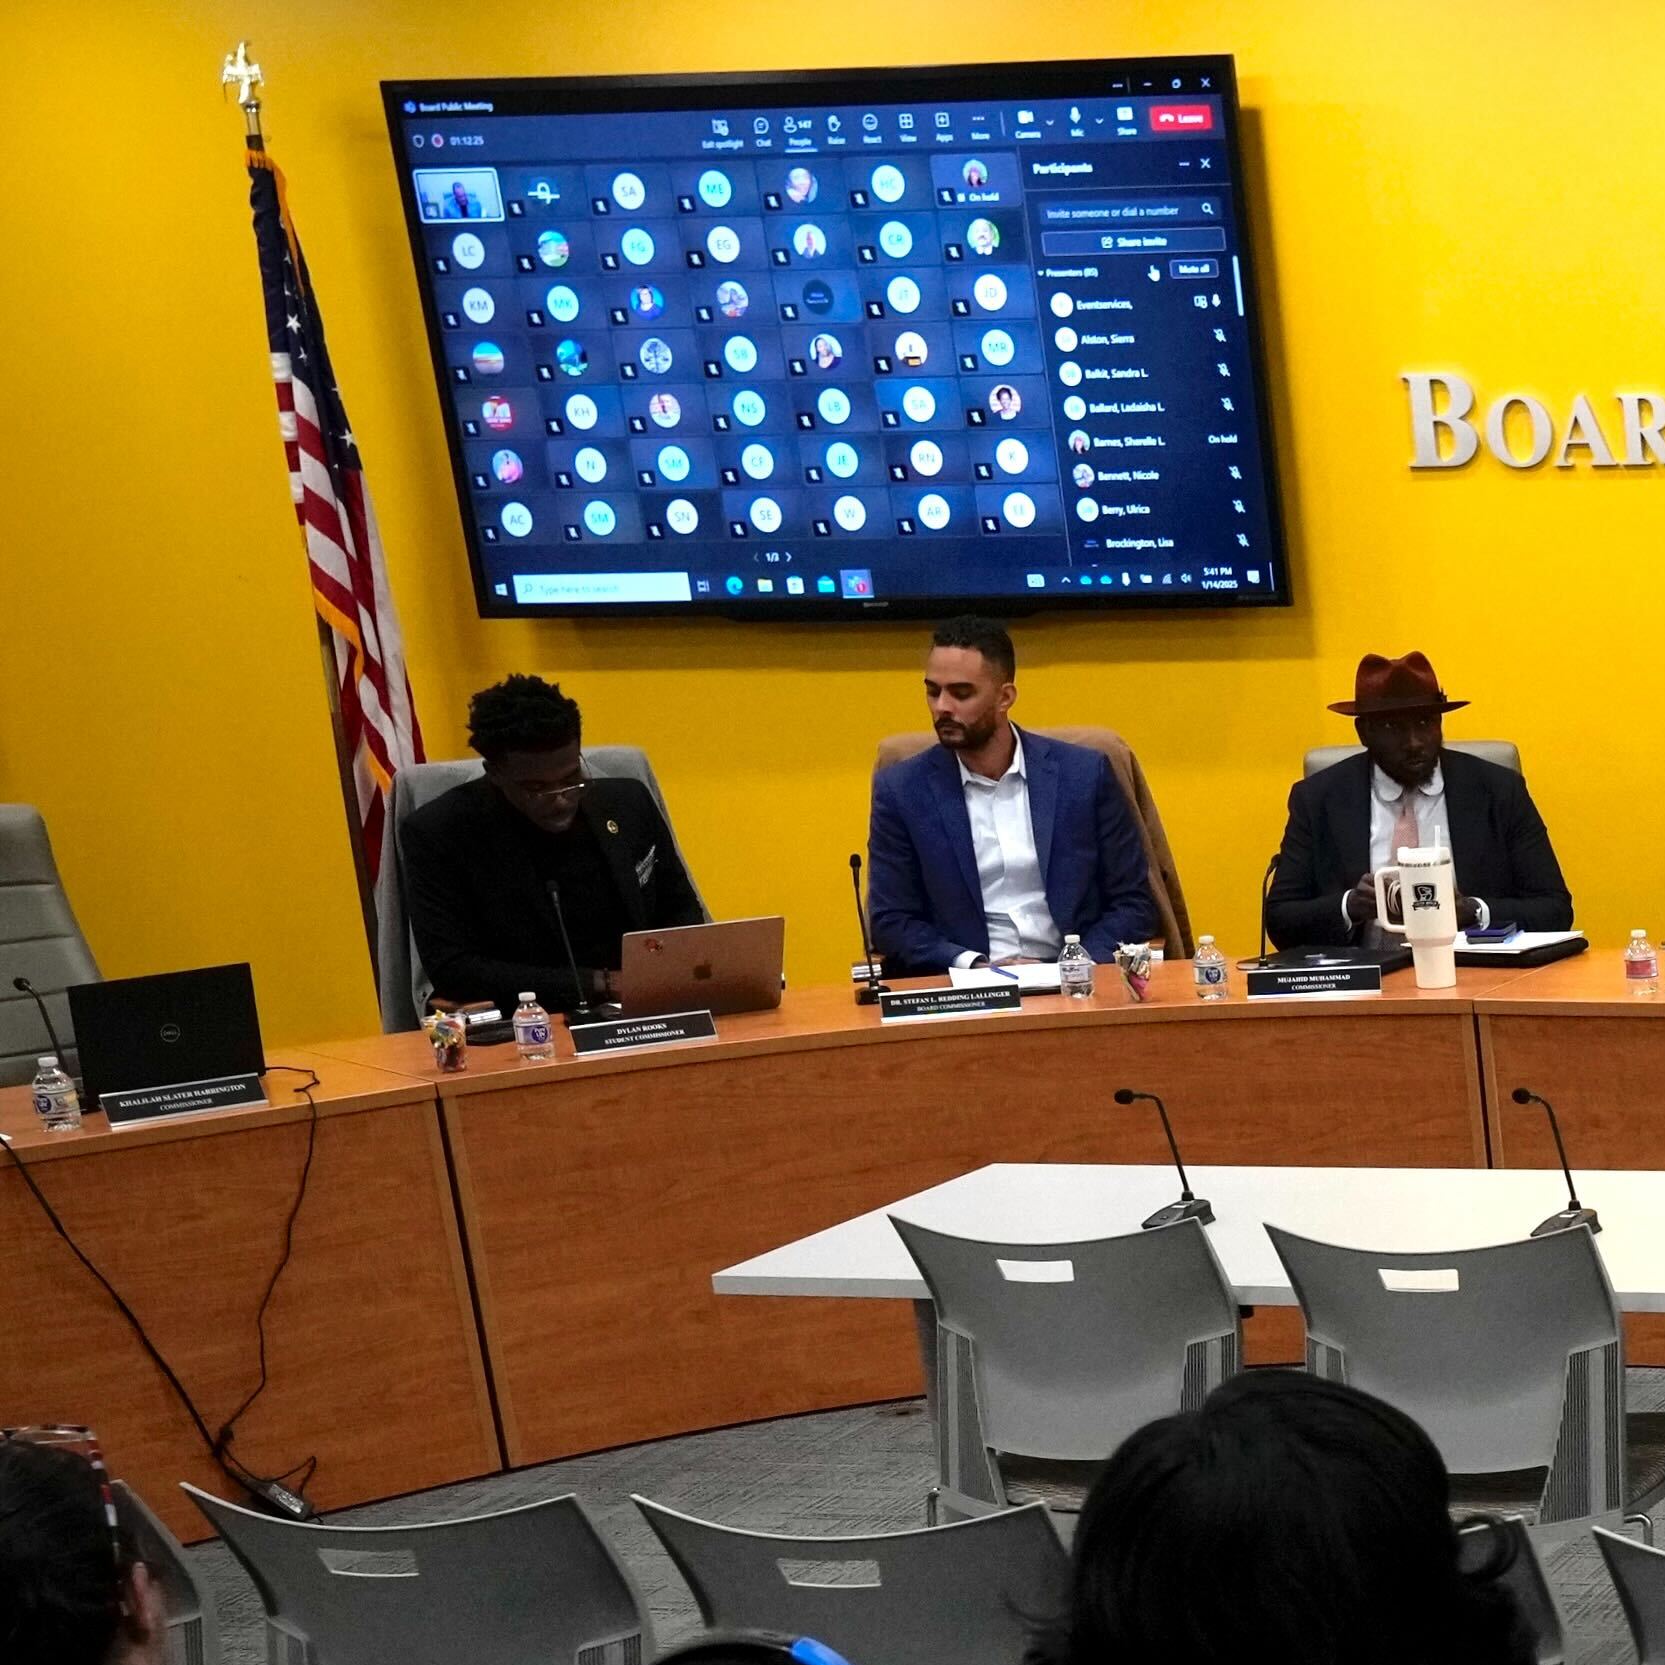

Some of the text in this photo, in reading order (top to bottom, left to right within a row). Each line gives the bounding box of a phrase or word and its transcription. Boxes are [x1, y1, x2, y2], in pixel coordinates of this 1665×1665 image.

[1033, 163, 1093, 176] Participants
[1047, 209, 1069, 218] Invite
[1072, 209, 1110, 218] someone
[1147, 207, 1178, 216] number
[1077, 301, 1133, 310] Eventservices,
[1111, 335, 1134, 343] Sierra
[1112, 369, 1140, 378] Sandra
[1208, 435, 1237, 443] On hold
[1133, 471, 1159, 480] Nicole
[1158, 538, 1174, 548] Lisa
[1204, 568, 1232, 576] 5:41 PM
[1202, 580, 1238, 589] 1/14/2025
[1277, 974, 1350, 984] MUJAHID MUHAMMAD
[1291, 983, 1336, 991] COMMISSIONER
[903, 997, 929, 1005] STEFAN
[938, 994, 969, 1002] REDDING
[971, 991, 1010, 1000] LALLINGER
[940, 1001, 985, 1010] COMMISSIONER
[617, 1023, 667, 1035] DYLAN ROOKS
[605, 1030, 685, 1045] STUDENT COMMISSIONER
[164, 1091, 192, 1102] SLATER
[194, 1084, 246, 1099] HARRINGTON
